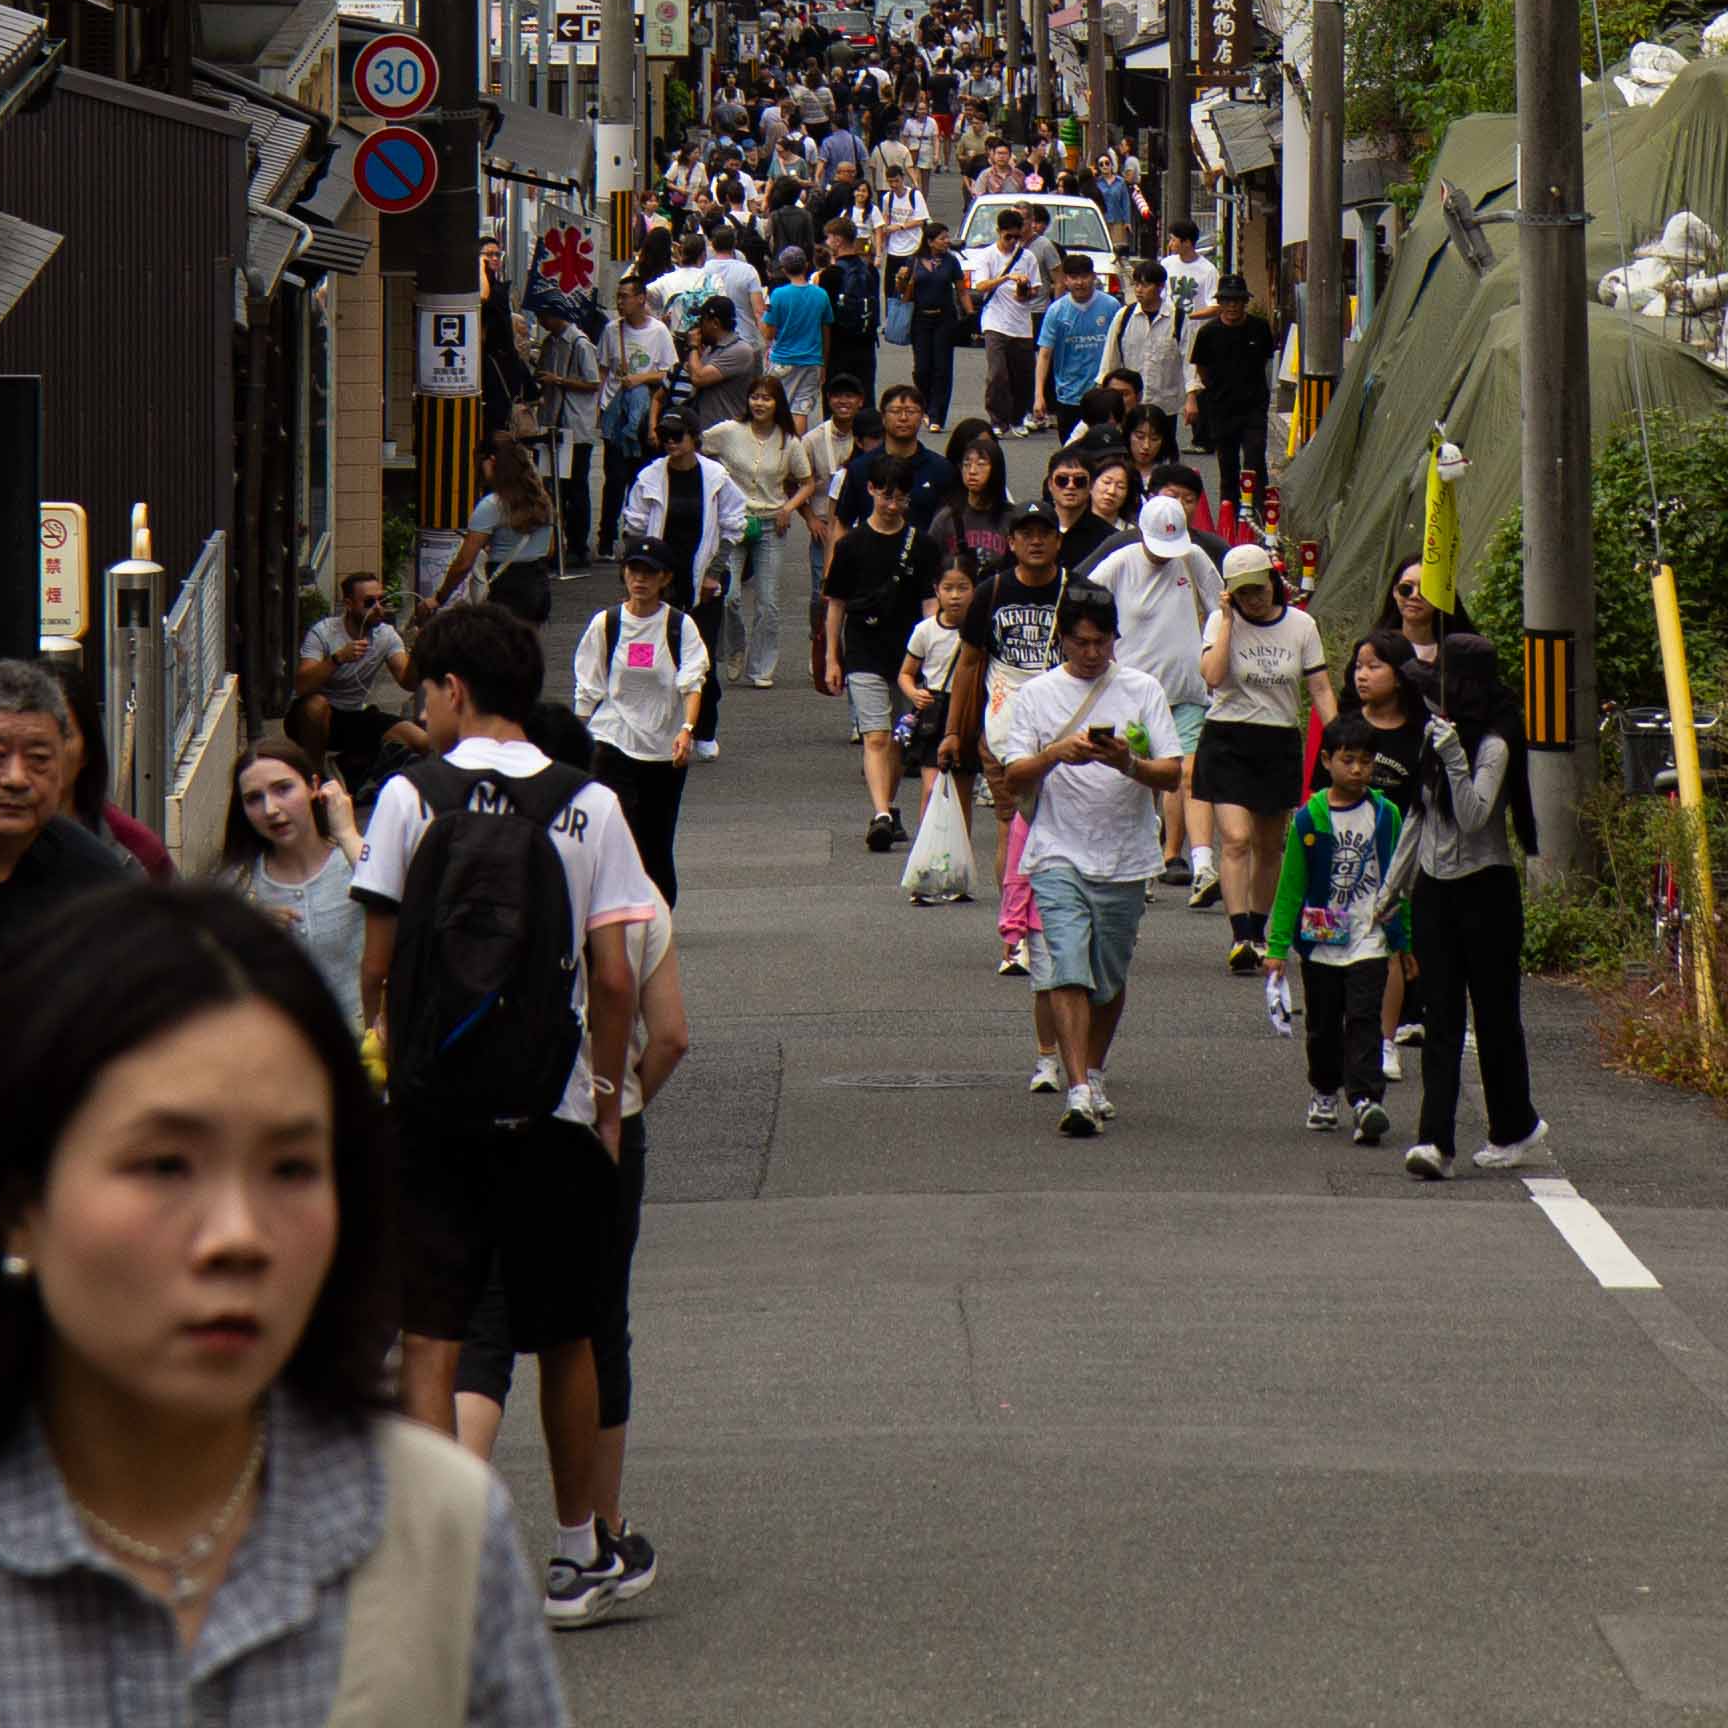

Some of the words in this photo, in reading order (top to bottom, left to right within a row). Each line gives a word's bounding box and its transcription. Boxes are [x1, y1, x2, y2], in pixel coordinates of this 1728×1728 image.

[374, 60, 419, 96] 30
[45, 558, 63, 604] 禁煙
[999, 608, 1055, 628] KENTUCK
